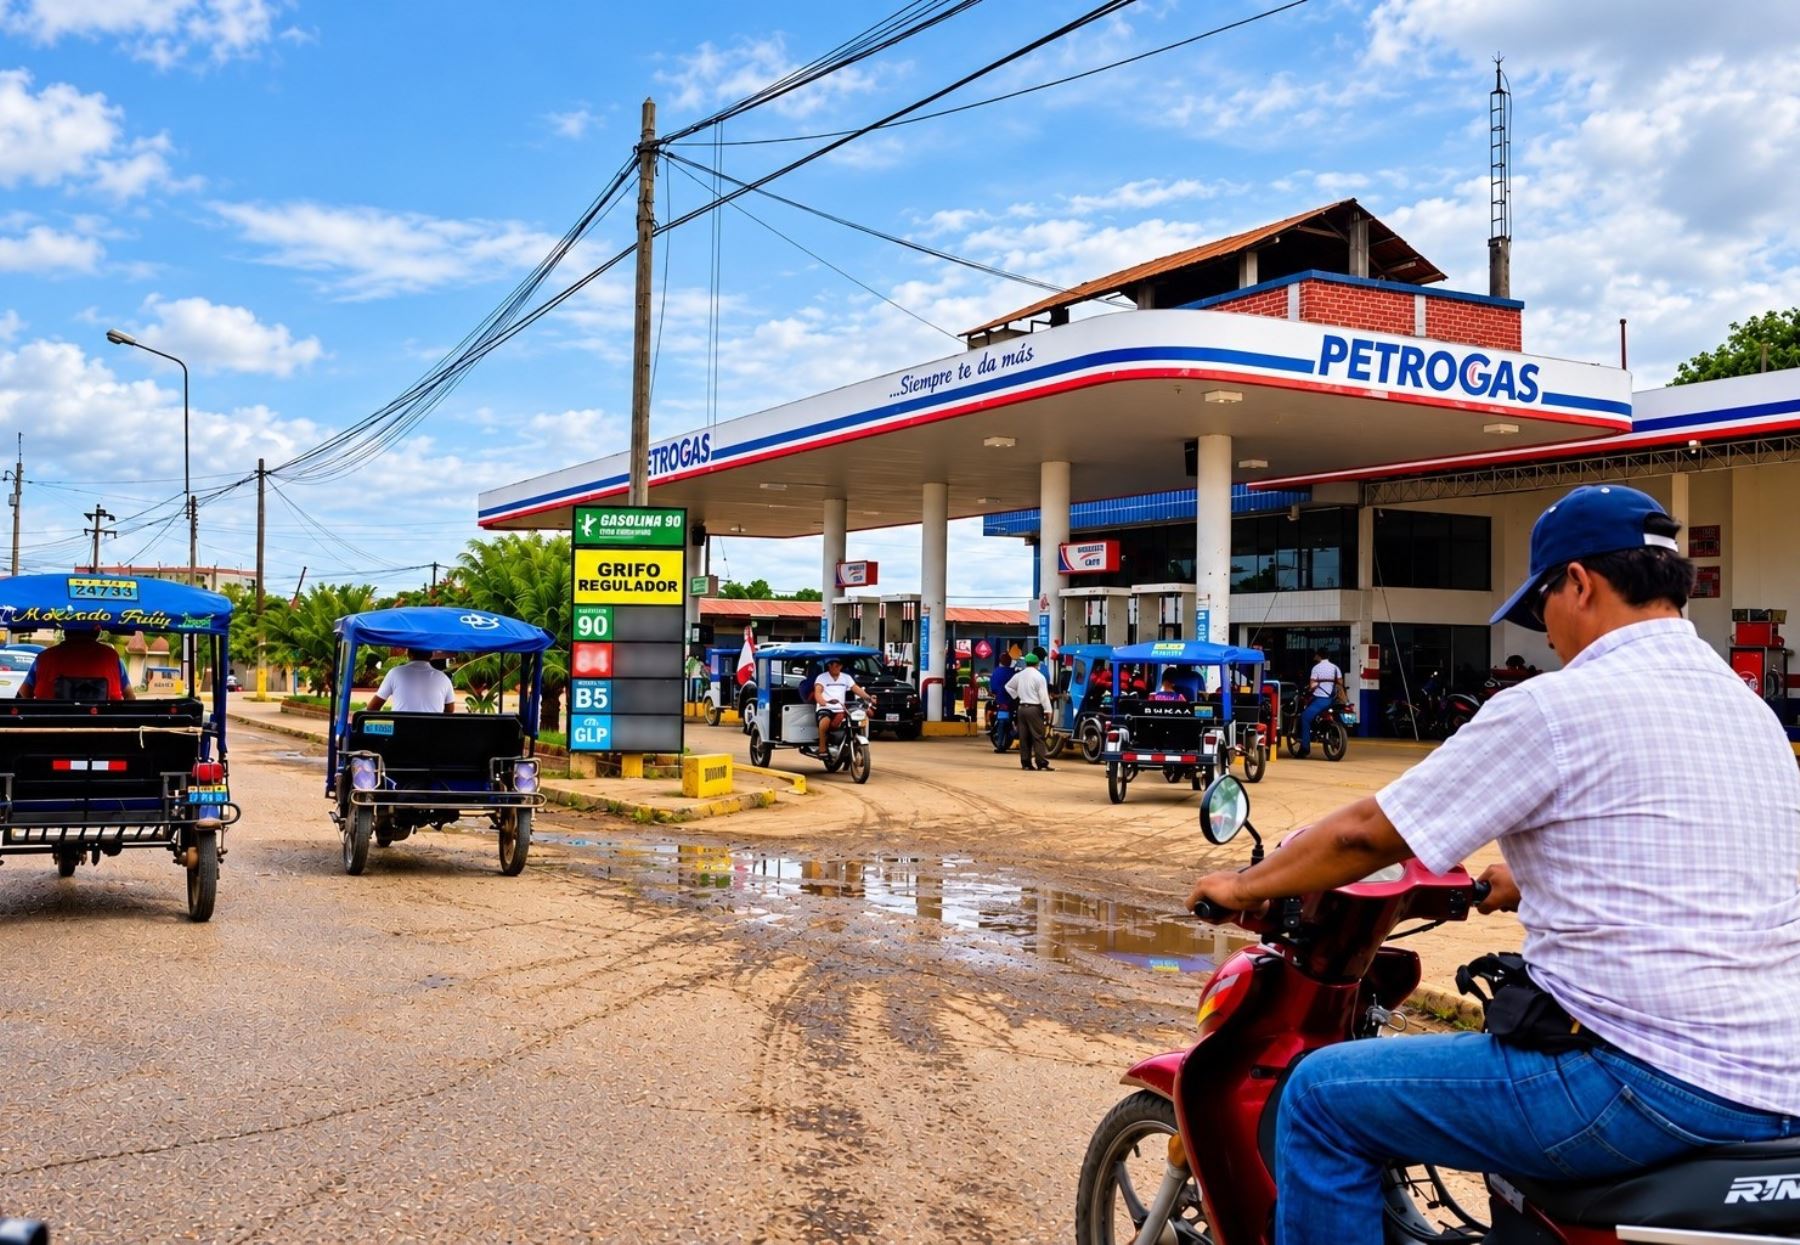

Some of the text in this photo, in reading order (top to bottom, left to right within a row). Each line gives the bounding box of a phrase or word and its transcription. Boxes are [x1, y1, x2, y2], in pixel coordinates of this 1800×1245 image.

[958, 362, 972, 380] te
[977, 352, 997, 375] da
[1001, 343, 1035, 368] más
[1318, 334, 1540, 403] PETROGAS
[600, 514, 682, 528] GASOLINA 90
[597, 562, 661, 578] GRIFO
[75, 585, 133, 597] 24733
[578, 579, 678, 592] REGULADOR
[577, 615, 608, 636] 90
[575, 687, 608, 709] B5
[574, 727, 608, 743] GLP
